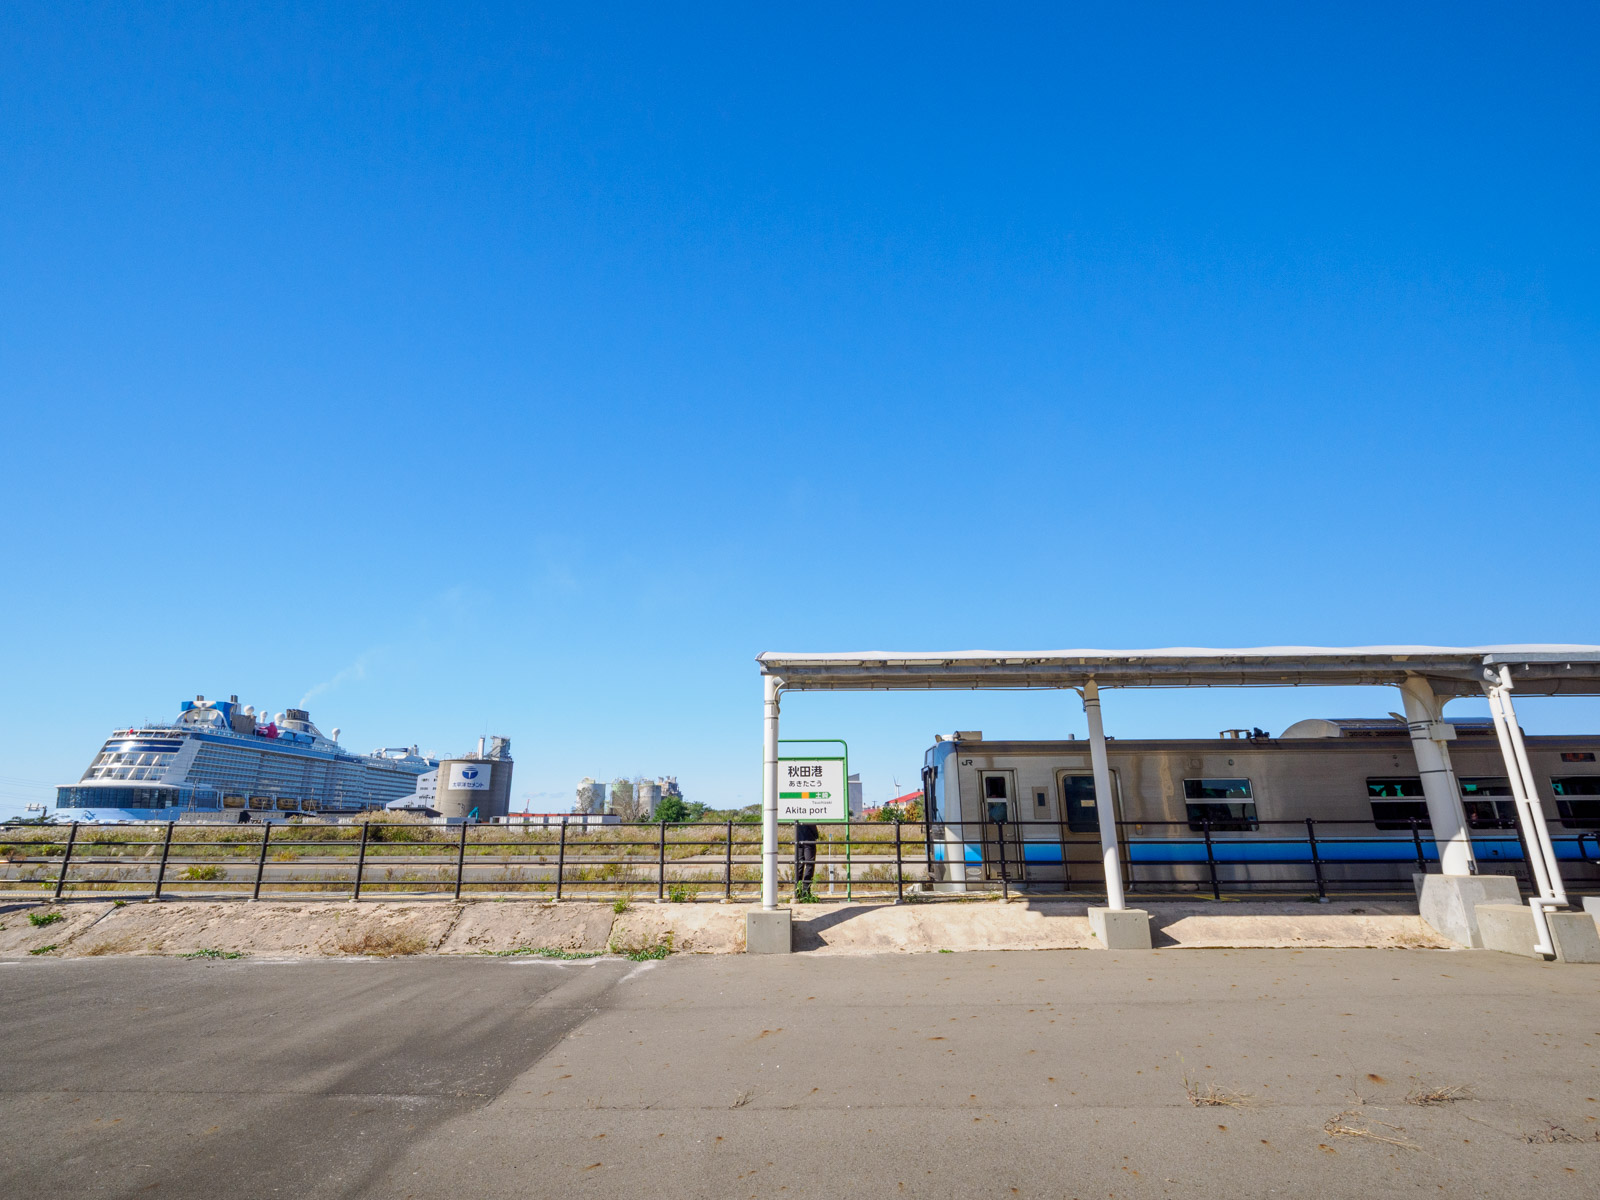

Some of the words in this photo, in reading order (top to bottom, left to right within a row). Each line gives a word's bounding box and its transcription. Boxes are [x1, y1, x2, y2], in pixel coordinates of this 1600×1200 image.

[788, 765, 823, 778] 秋田港
[788, 780, 822, 788] あきたこう
[785, 806, 807, 814] Akita
[809, 806, 827, 815] port
